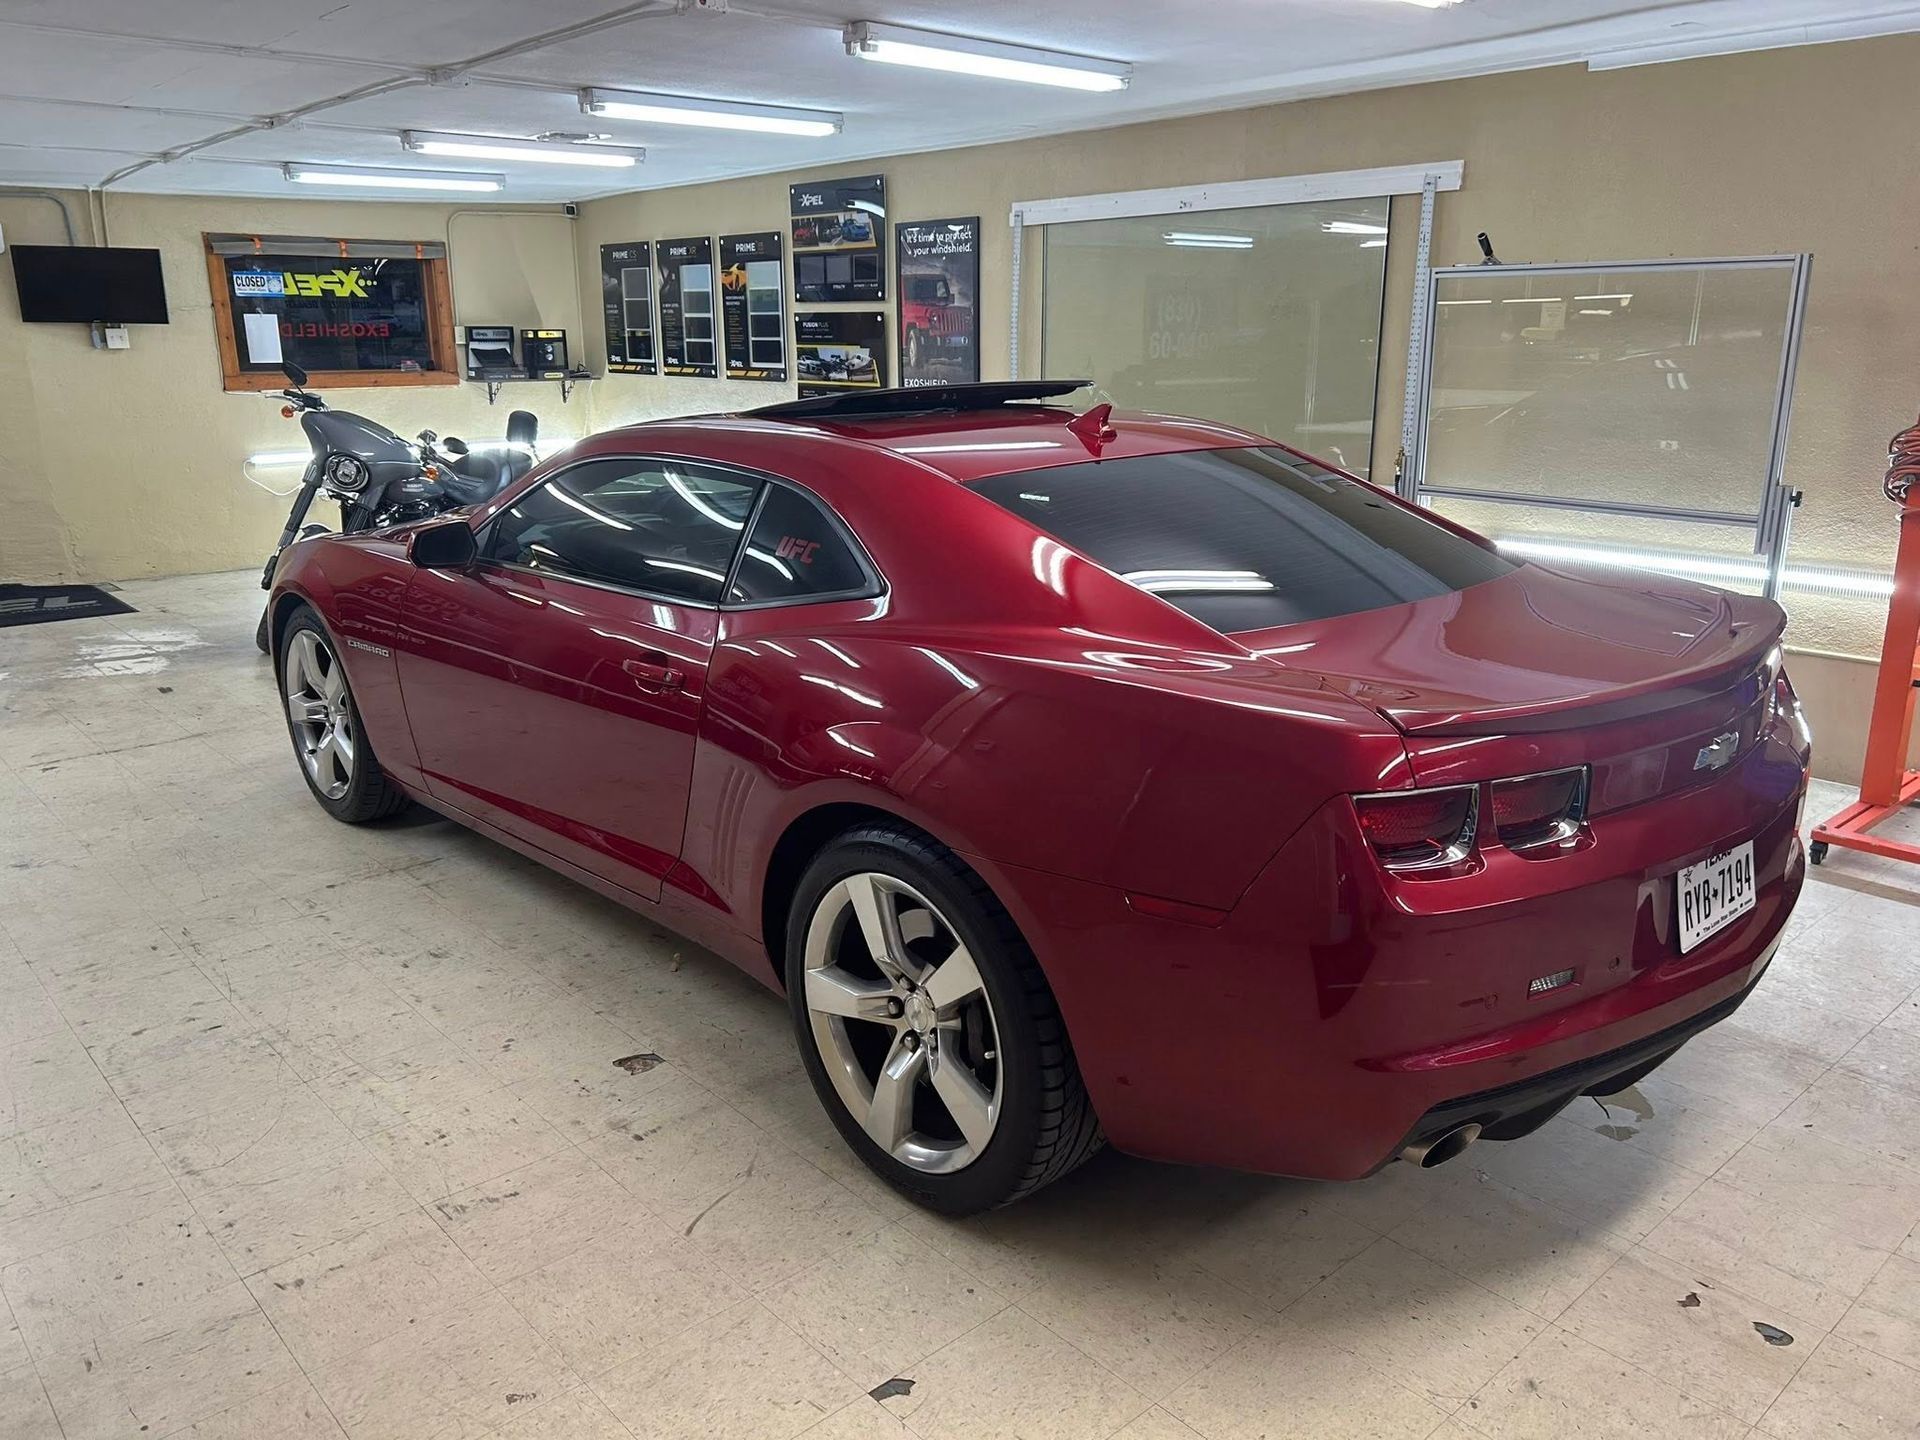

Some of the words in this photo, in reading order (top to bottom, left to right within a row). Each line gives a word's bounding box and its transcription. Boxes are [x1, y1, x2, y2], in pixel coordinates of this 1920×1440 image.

[800, 193, 824, 206] XPEL
[945, 230, 972, 243] protect
[670, 246, 687, 256] PRIME
[735, 242, 756, 252] PRIME
[913, 247, 929, 258] your
[612, 250, 628, 260] PRIME
[235, 275, 266, 288] CLOSED
[775, 535, 821, 565] UFC
[347, 639, 390, 657] CAMARO
